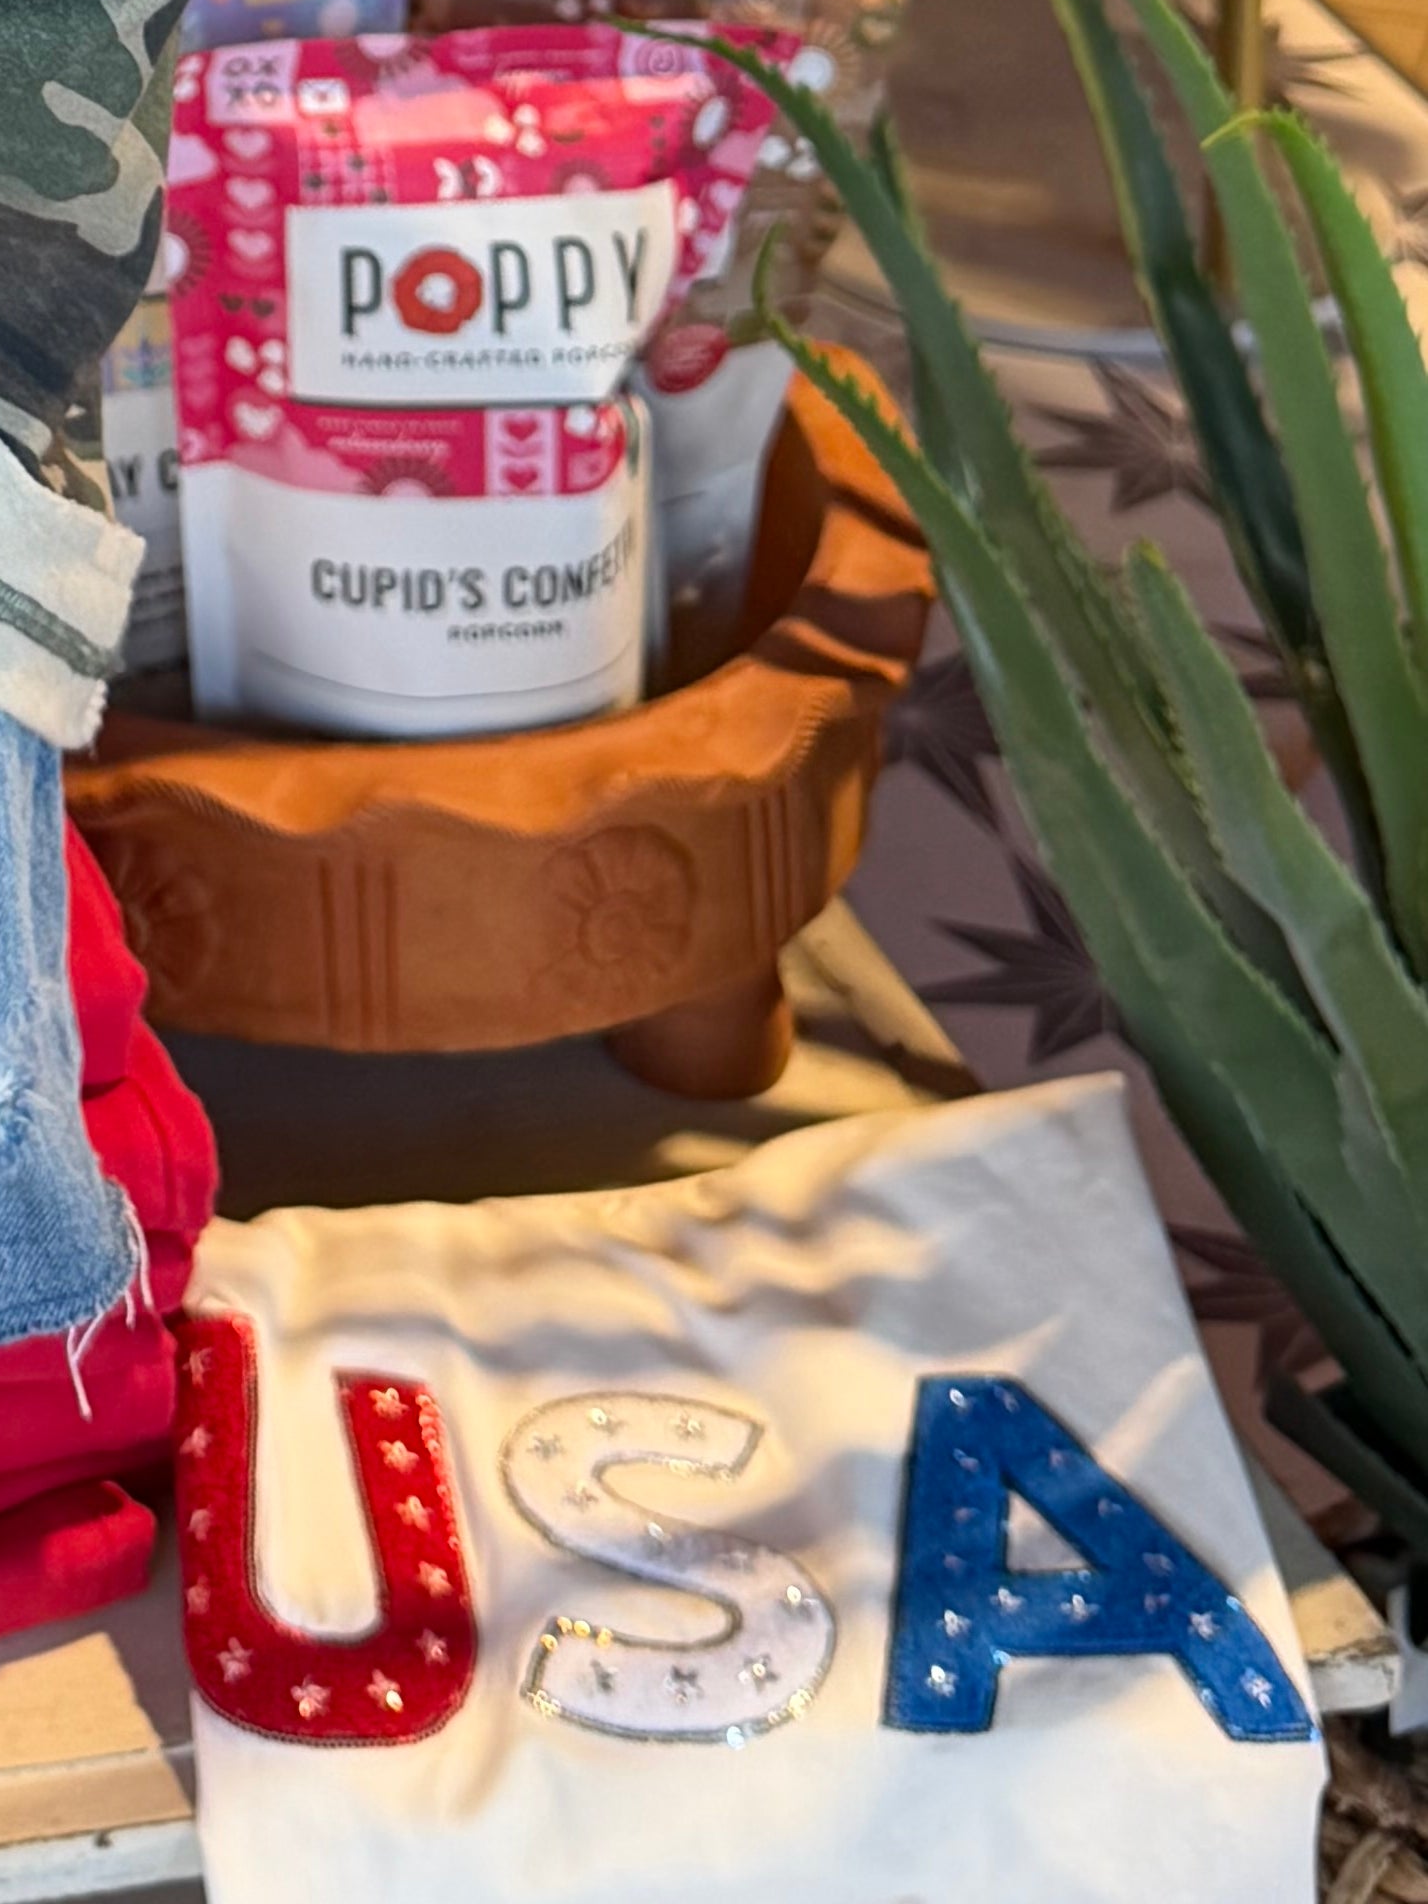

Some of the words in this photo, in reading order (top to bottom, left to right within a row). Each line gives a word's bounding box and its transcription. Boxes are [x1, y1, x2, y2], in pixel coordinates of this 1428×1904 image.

[340, 226, 648, 337] POPPY
[310, 558, 485, 611] CUPID'S
[174, 1309, 1319, 1748] USA
